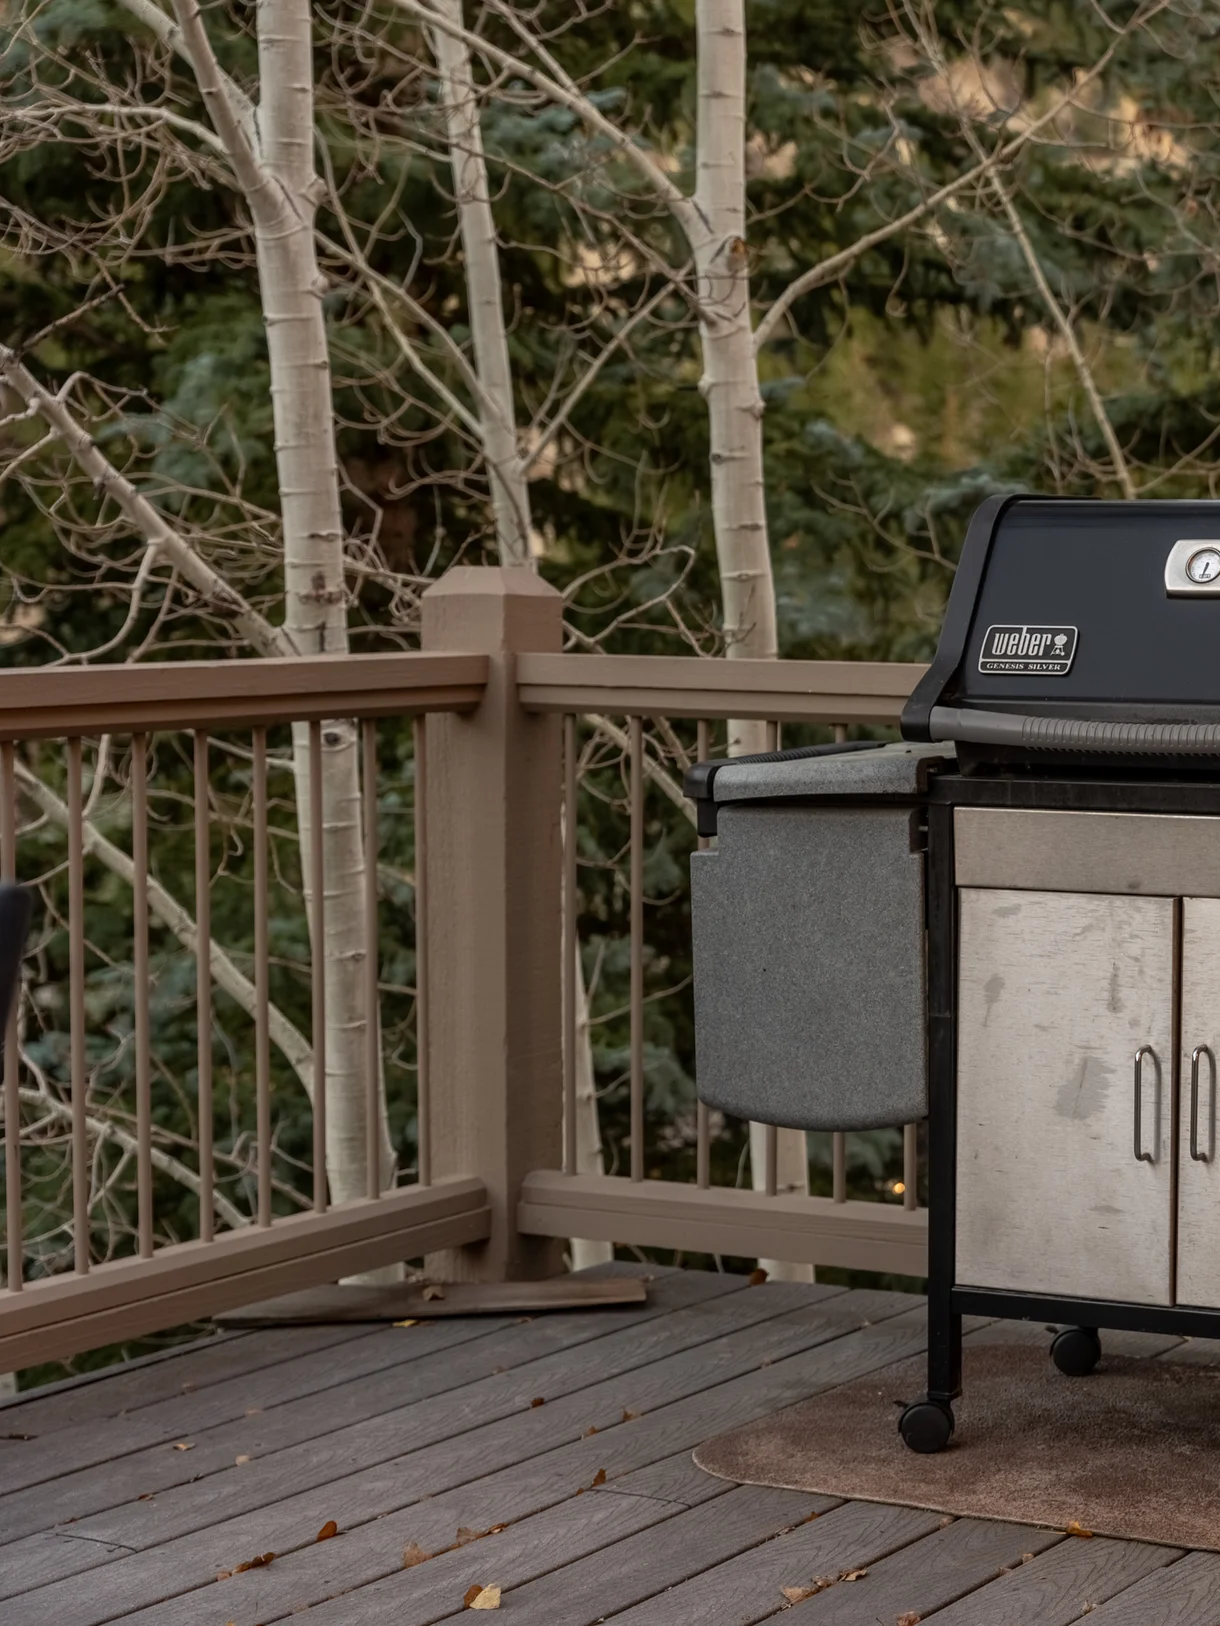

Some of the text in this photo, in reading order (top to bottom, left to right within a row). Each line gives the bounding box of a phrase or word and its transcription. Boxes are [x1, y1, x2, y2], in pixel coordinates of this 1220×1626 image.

[991, 627, 1052, 656] weber
[986, 662, 1061, 671] GENESIS SILVER
